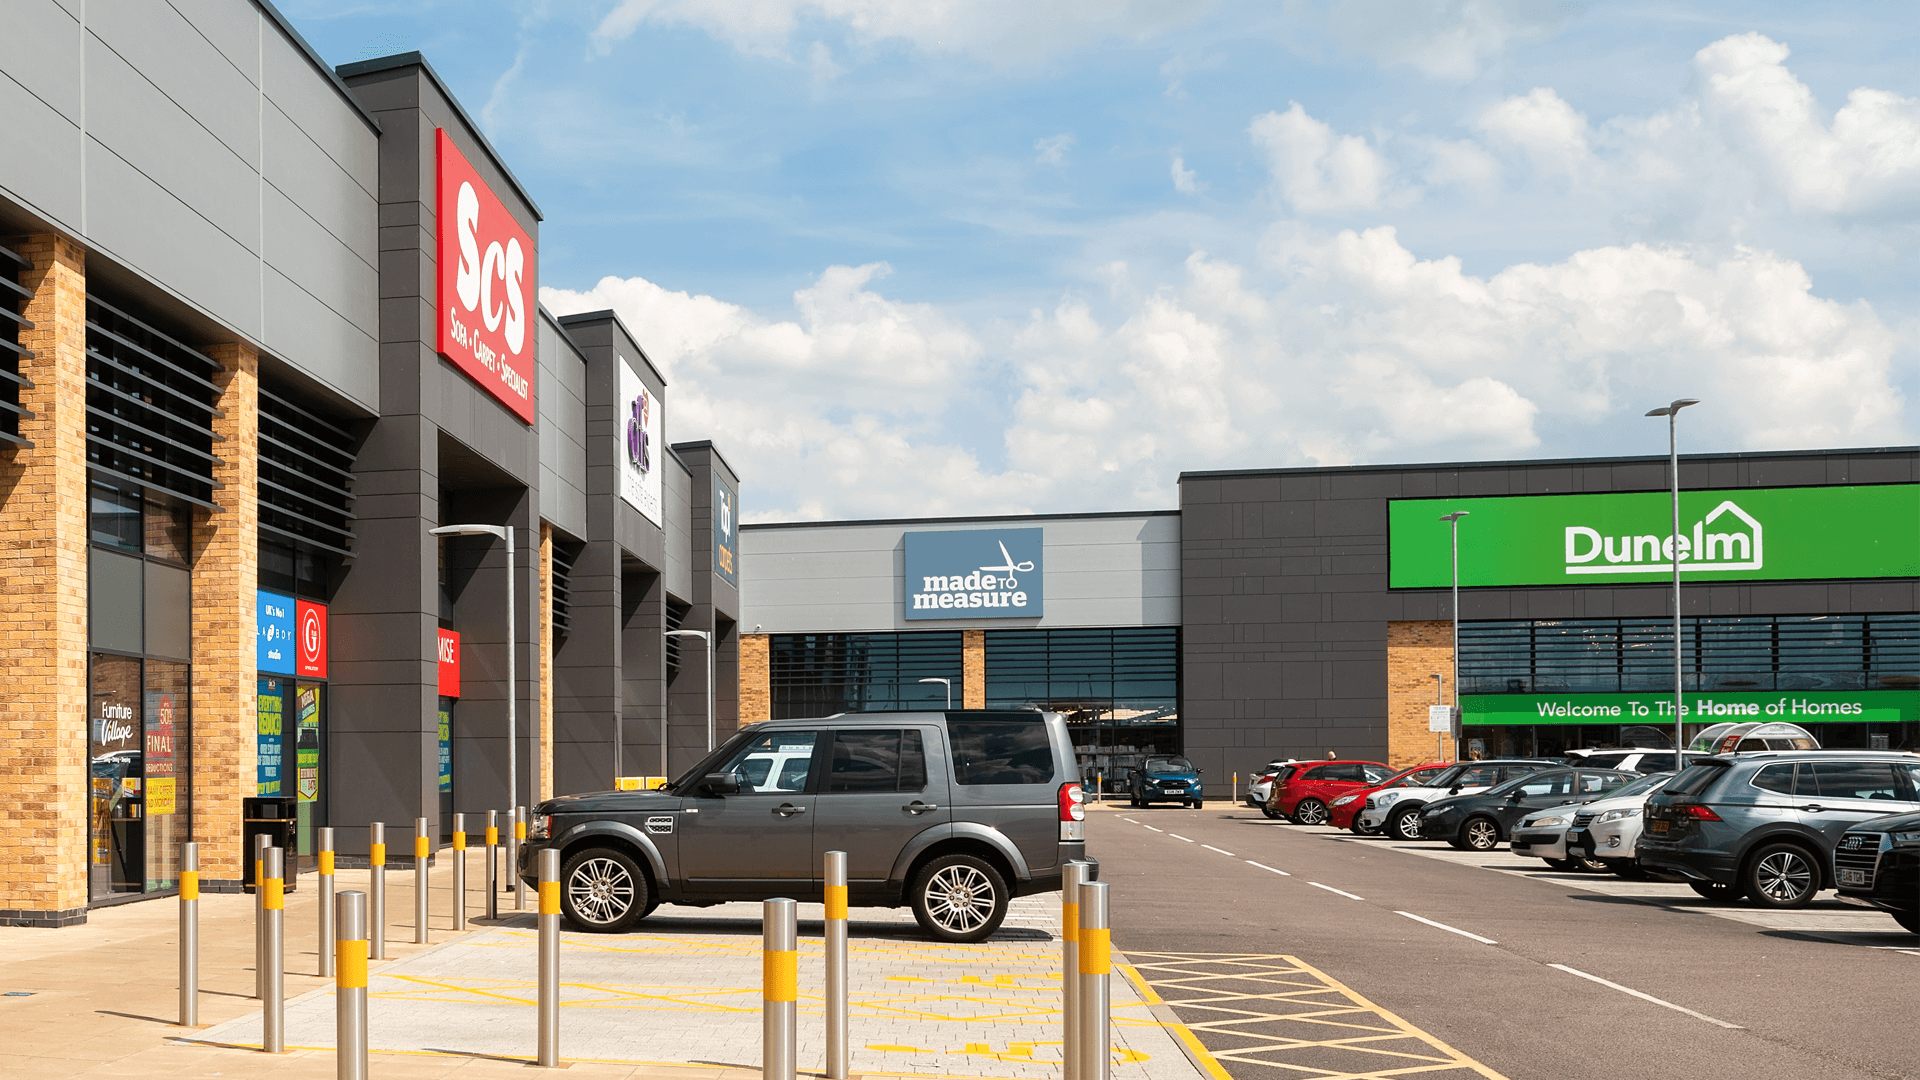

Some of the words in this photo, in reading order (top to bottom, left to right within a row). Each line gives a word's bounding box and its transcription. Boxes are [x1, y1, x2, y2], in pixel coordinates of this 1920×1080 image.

[1565, 519, 1751, 564] Dunelm
[923, 570, 996, 592] made
[913, 590, 1028, 609] measure
[102, 701, 132, 720] Furniture
[1536, 701, 1622, 717] Welcome
[1627, 701, 1650, 716] To
[1654, 700, 1690, 716] The
[1697, 699, 1760, 716] Home
[1765, 697, 1787, 715] of
[1792, 698, 1863, 715] Homes
[101, 719, 133, 748] Village
[147, 735, 172, 753] FINAL
